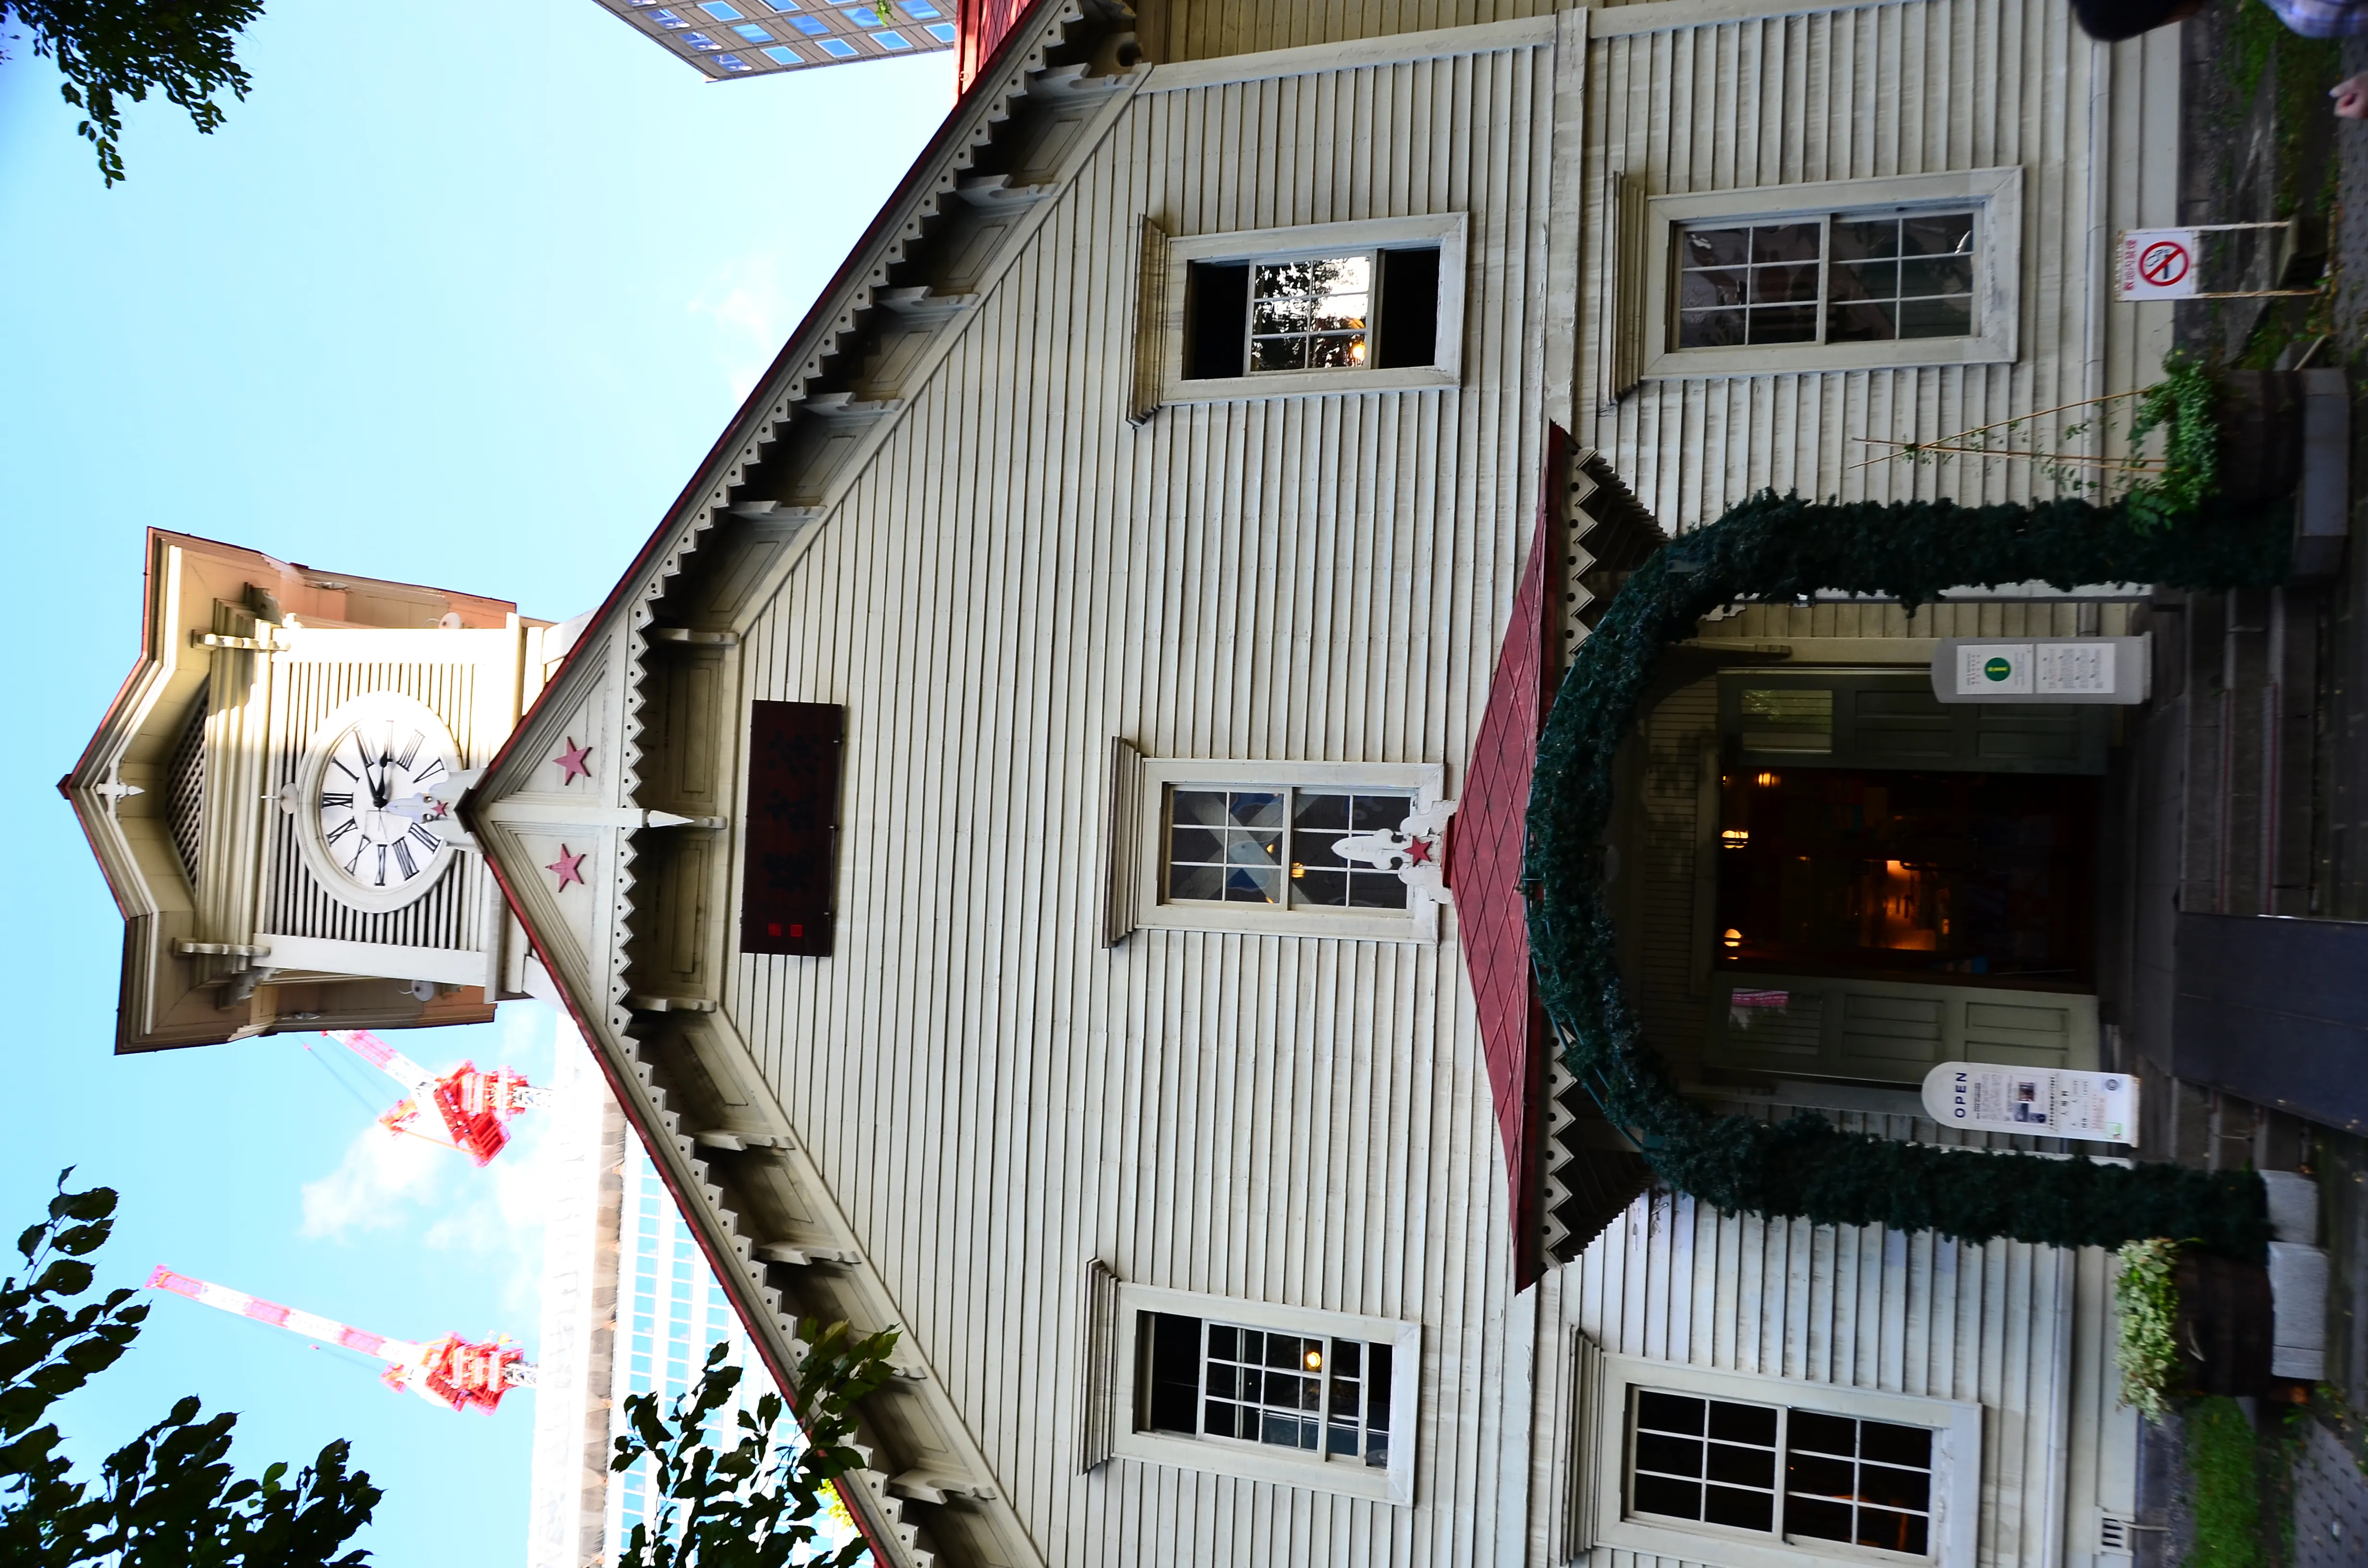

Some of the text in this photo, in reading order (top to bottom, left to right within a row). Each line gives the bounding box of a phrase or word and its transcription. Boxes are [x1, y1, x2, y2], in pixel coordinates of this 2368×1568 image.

[331, 756, 359, 783] I
[321, 791, 353, 808] XII
[326, 816, 358, 846] XI
[344, 834, 370, 875] X
[374, 844, 386, 885] IX
[392, 836, 419, 881] VIII
[1955, 1072, 1967, 1117] OPEN
